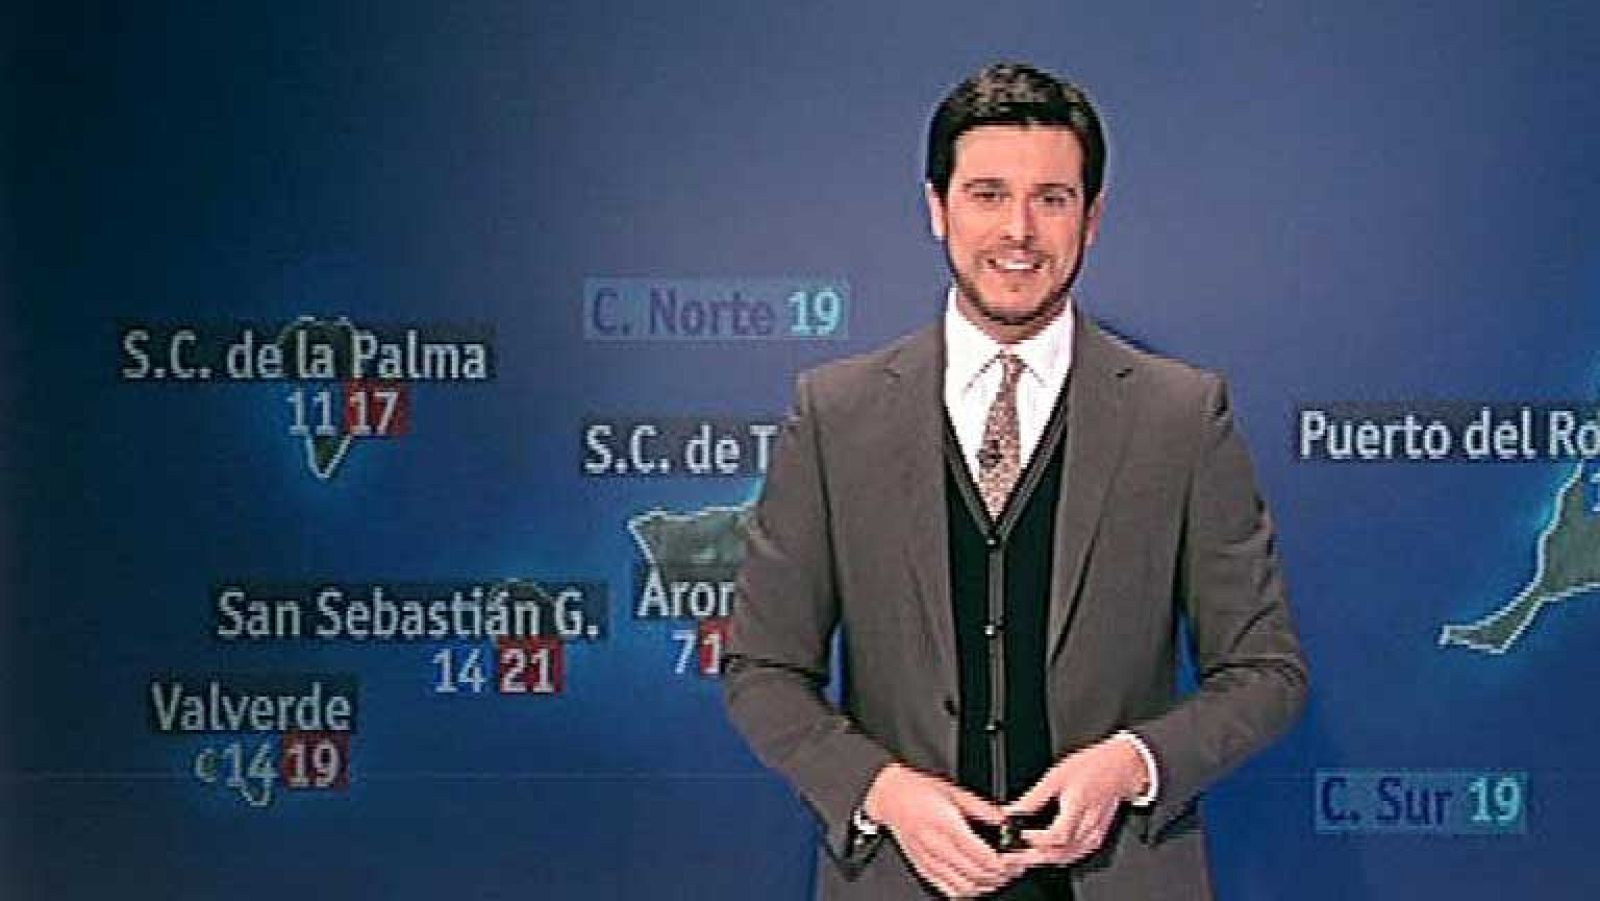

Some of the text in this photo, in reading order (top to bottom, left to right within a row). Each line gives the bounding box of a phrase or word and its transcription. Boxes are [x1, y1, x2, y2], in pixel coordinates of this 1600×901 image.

[592, 285, 843, 336] C. Norte 19
[122, 329, 487, 379] S.C. de la Palma
[288, 390, 398, 435] 11 17
[1300, 410, 1451, 459] Puerto
[1465, 406, 1535, 459] del
[584, 424, 670, 474] S.C.
[685, 424, 740, 474] de
[217, 587, 600, 637] San Sebastián G.
[432, 649, 554, 693] 14 21
[672, 630, 695, 675] 7
[151, 682, 351, 731] Valverde
[225, 744, 341, 788] 14 19
[1322, 776, 1522, 826] C. Sur 19
